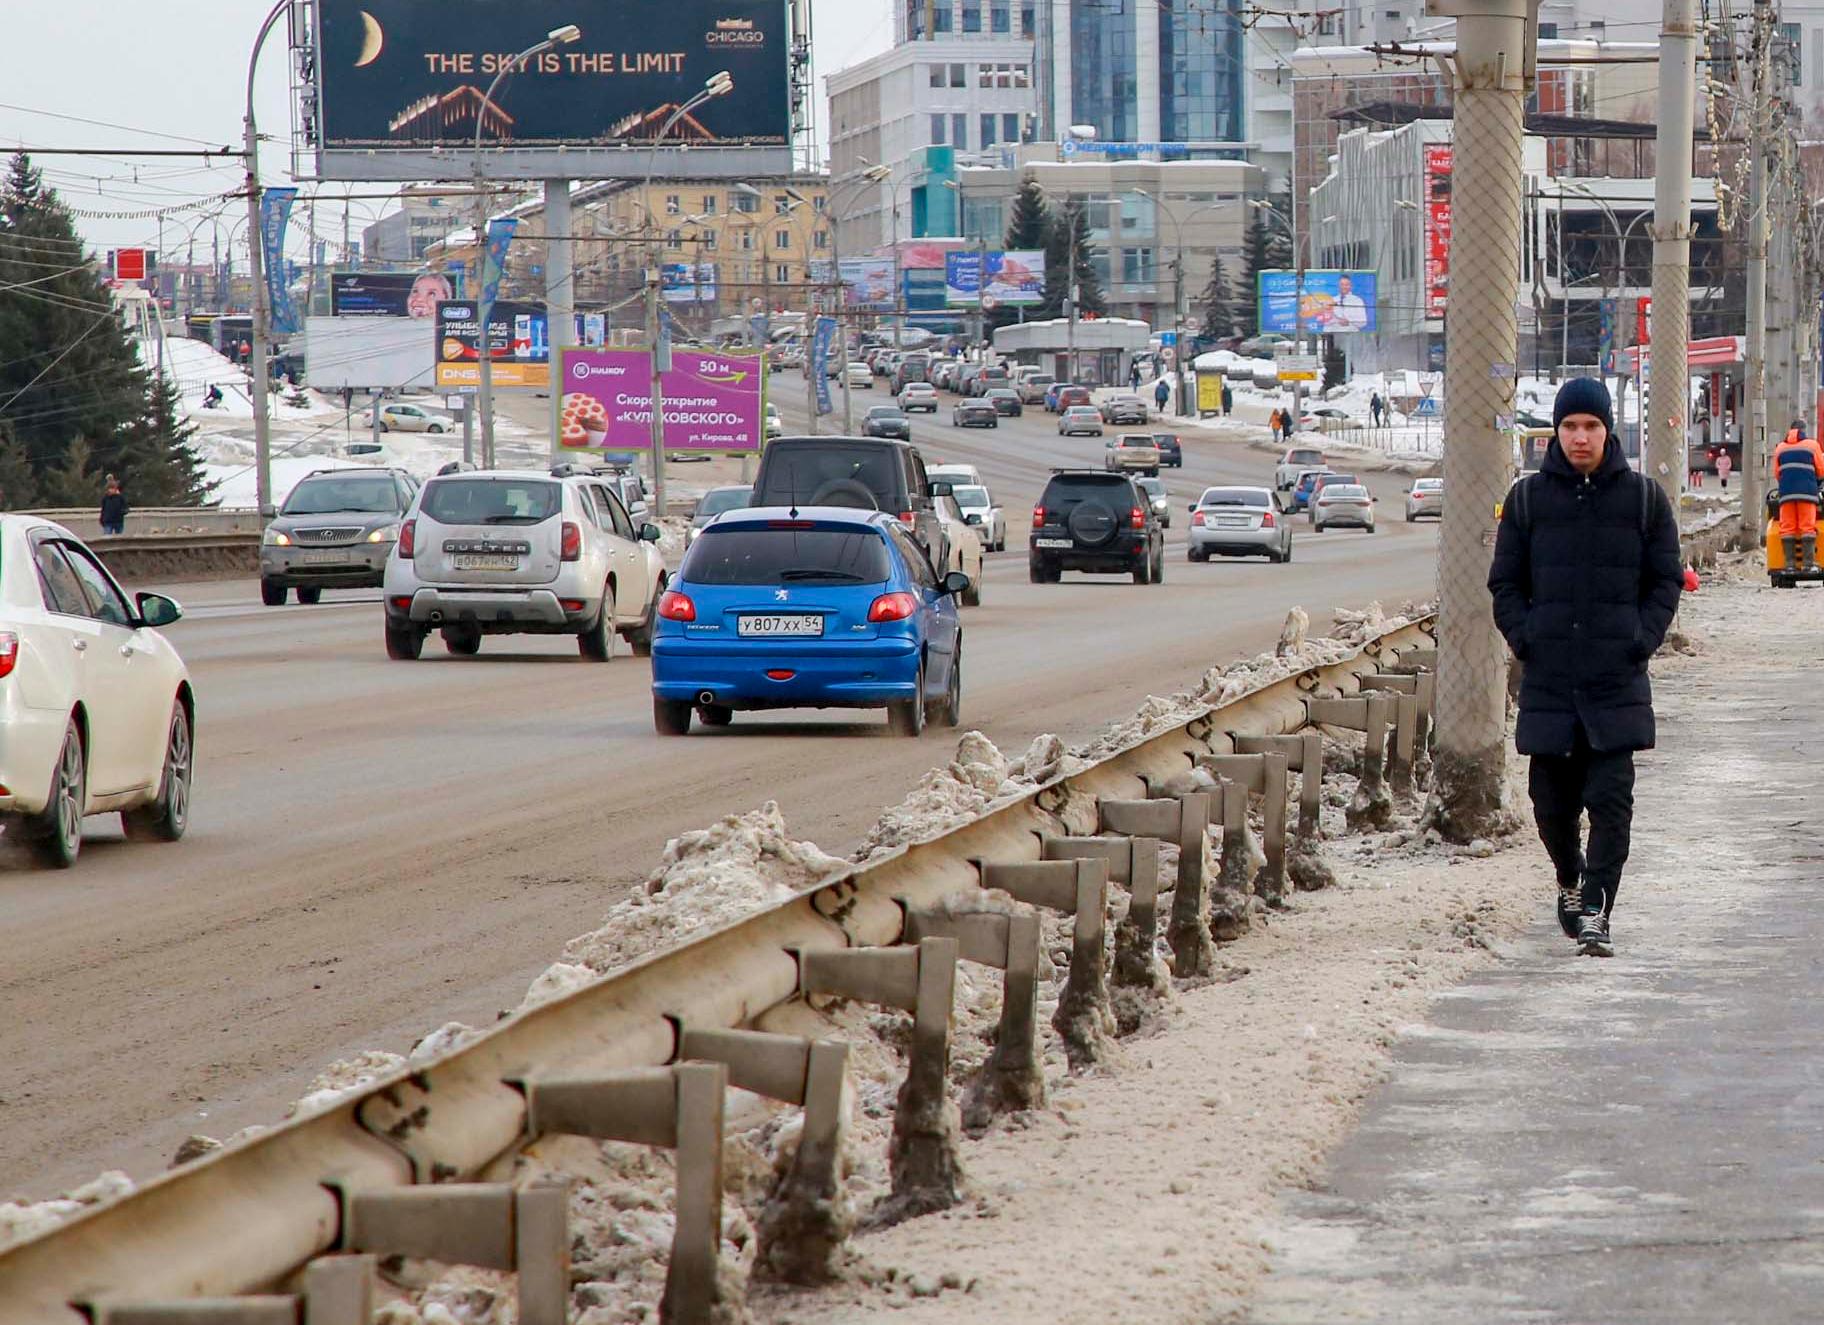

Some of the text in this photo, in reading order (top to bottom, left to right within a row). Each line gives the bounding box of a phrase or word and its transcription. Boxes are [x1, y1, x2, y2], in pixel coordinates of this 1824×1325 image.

[705, 31, 764, 42] CHICAGO
[424, 53, 686, 73] THE SKY IS THE LIMIT
[699, 361, 729, 372] 50 м
[442, 369, 477, 379] DNS
[661, 396, 718, 409] открытие
[804, 616, 819, 627] 54
